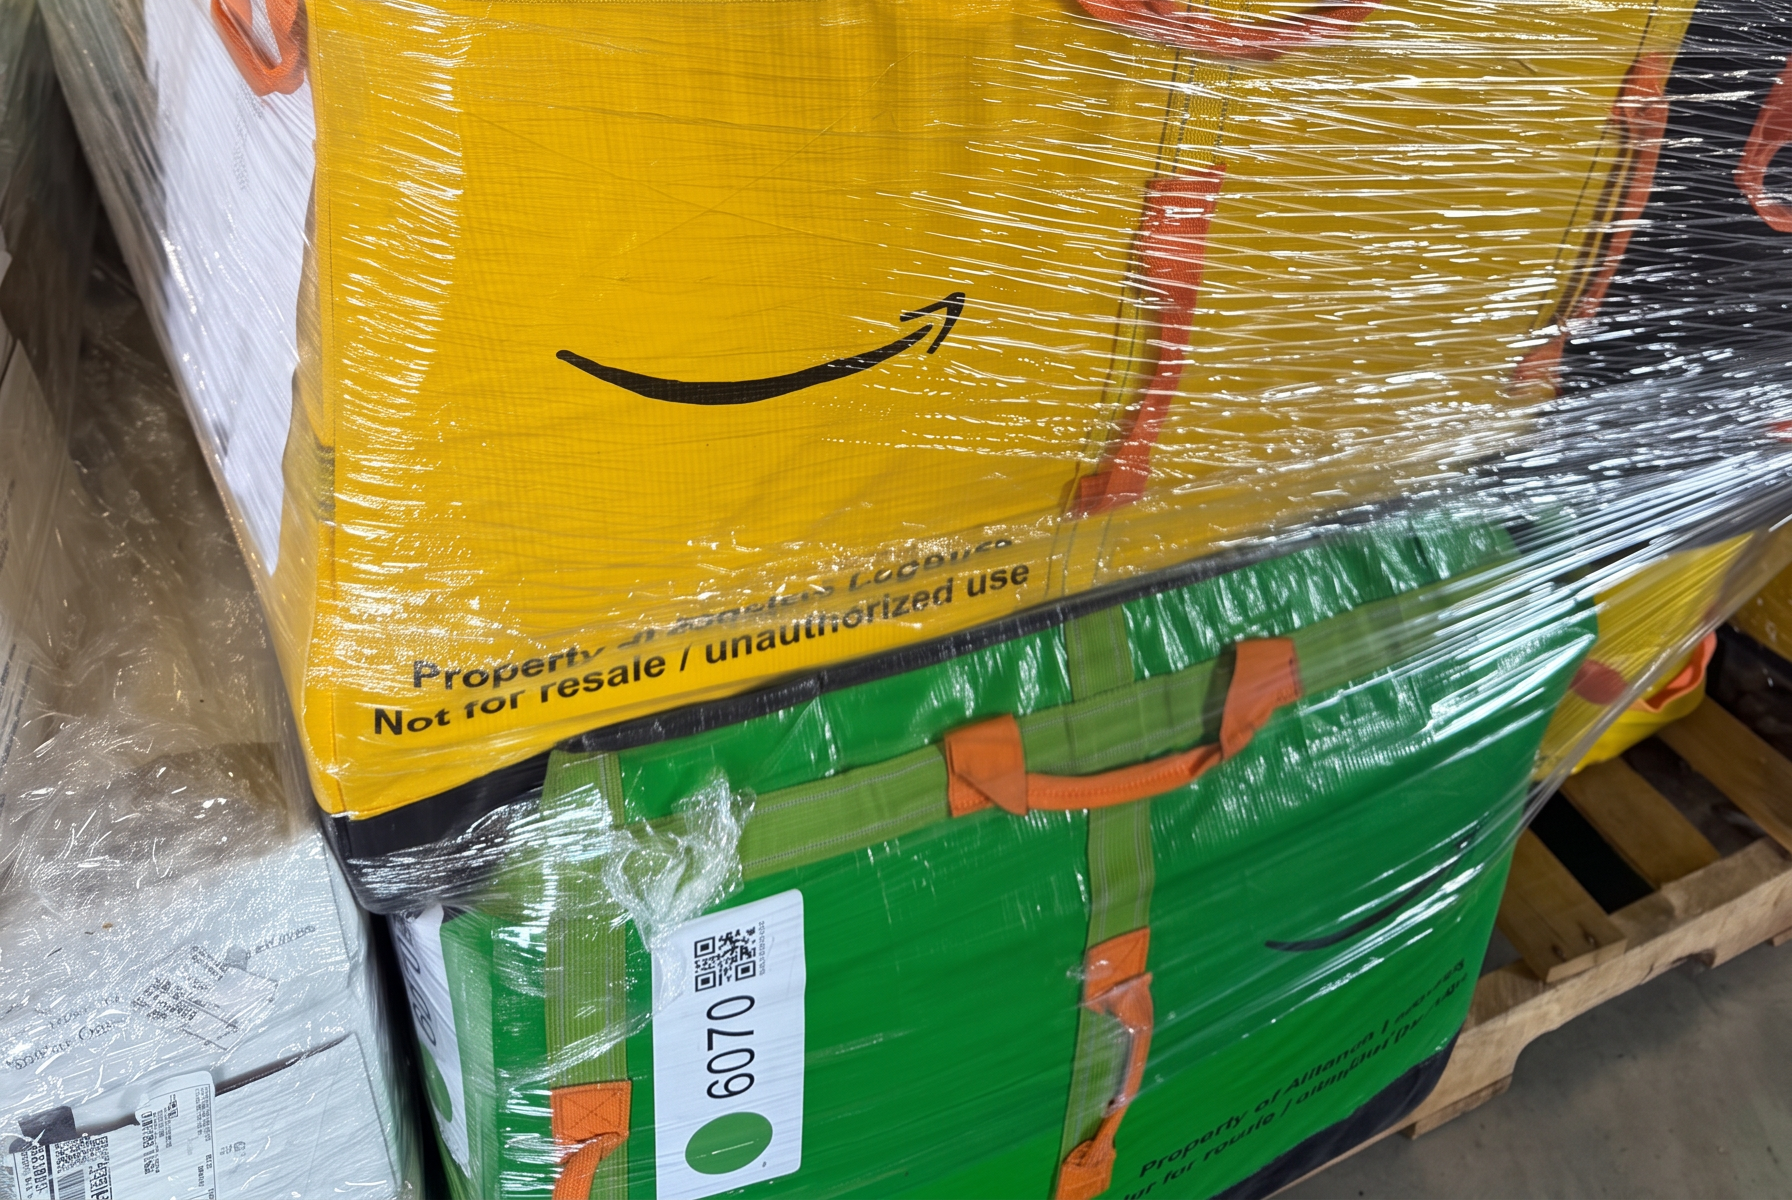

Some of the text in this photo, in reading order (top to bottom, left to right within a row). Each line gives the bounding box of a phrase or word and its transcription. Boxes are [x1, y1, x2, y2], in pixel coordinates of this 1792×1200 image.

[374, 705, 451, 735] Not
[464, 689, 525, 719] for
[540, 654, 666, 703] resale
[705, 577, 953, 664] unauthorized
[966, 563, 1030, 597] use
[706, 994, 756, 1099] 6070
[1139, 1110, 1249, 1178] Property
